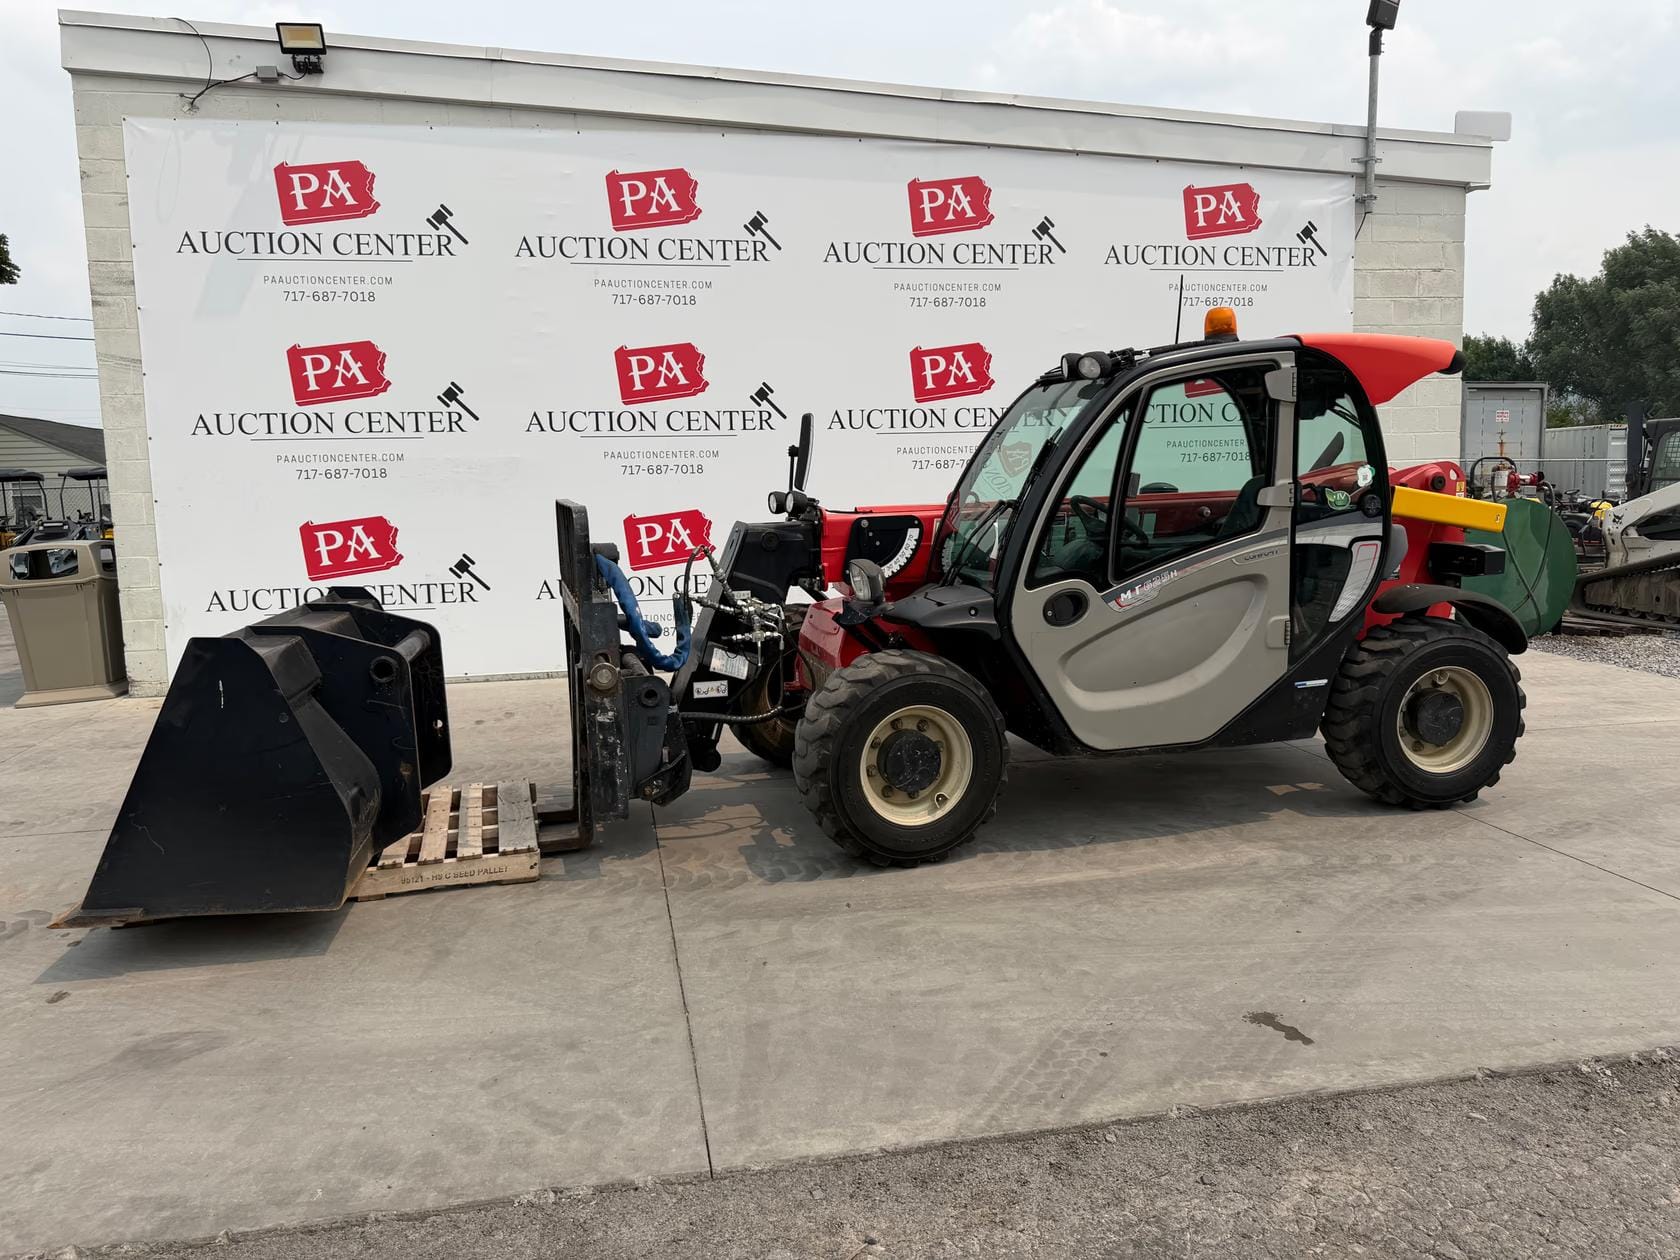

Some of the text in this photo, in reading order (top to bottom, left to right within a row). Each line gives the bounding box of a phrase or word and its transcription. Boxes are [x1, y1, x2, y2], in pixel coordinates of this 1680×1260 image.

[289, 170, 358, 210] PA
[619, 177, 682, 216] PA
[920, 184, 976, 223] PA
[1194, 191, 1245, 227] PA
[176, 231, 457, 257] AUCTION CENTER
[514, 236, 770, 262] AUCTION CENTER
[823, 242, 1056, 265] AUCTION CENTER
[1104, 245, 1317, 267] AUCTION CENTER
[263, 275, 393, 286] PAAUCTIONCENTER.COM
[594, 279, 712, 290] PAAUCTIONCENTER.COM
[894, 283, 1001, 292] PAAUCTIONCENTER.COM
[283, 290, 376, 303] 717-687-7018
[612, 294, 697, 306] 717-687-7018
[909, 297, 986, 308] 717-687-7018
[1182, 296, 1254, 307] 717-687-7018
[301, 350, 369, 391] PA
[628, 351, 689, 390] PA
[921, 352, 977, 389] PA
[191, 411, 468, 436] AUCTION CENTER
[525, 410, 776, 433] AUCTION CENTER
[827, 407, 1055, 430] AUCTION CENER
[603, 450, 720, 459] PAAUCTIONCENTER.COM
[1166, 439, 1247, 449] PAAUCTIONCENTER.
[276, 453, 405, 463] PAAUCTIONCENTER.COM
[621, 464, 704, 475] 717-687-7018
[912, 459, 970, 470] 717-687-7
[296, 468, 388, 480] 717-687-7018
[314, 526, 382, 566] PA
[636, 518, 697, 557] PA
[205, 582, 479, 612] AUCTIO ENTER
